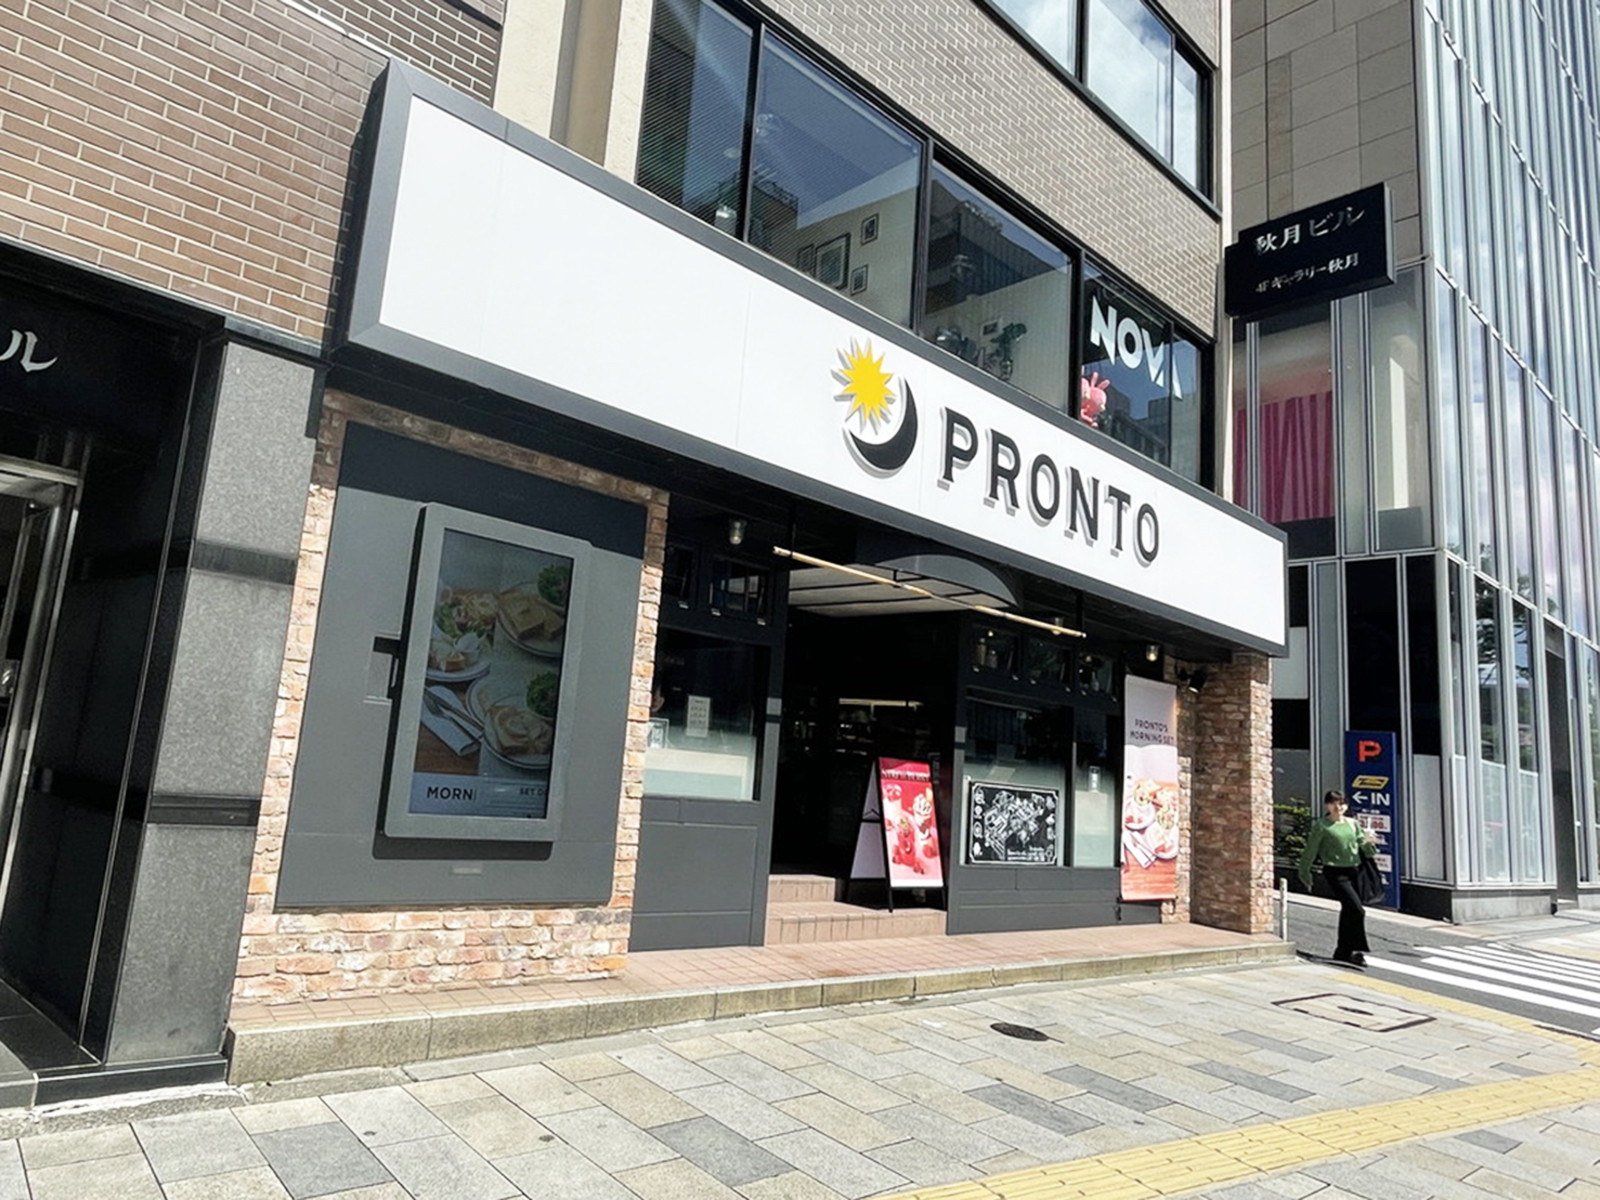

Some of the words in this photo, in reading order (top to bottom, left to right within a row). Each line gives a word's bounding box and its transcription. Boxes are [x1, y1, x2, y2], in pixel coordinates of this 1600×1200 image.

[940, 406, 1160, 564] PRONTO
[1358, 740, 1382, 763] P
[1370, 792, 1391, 807] IN
